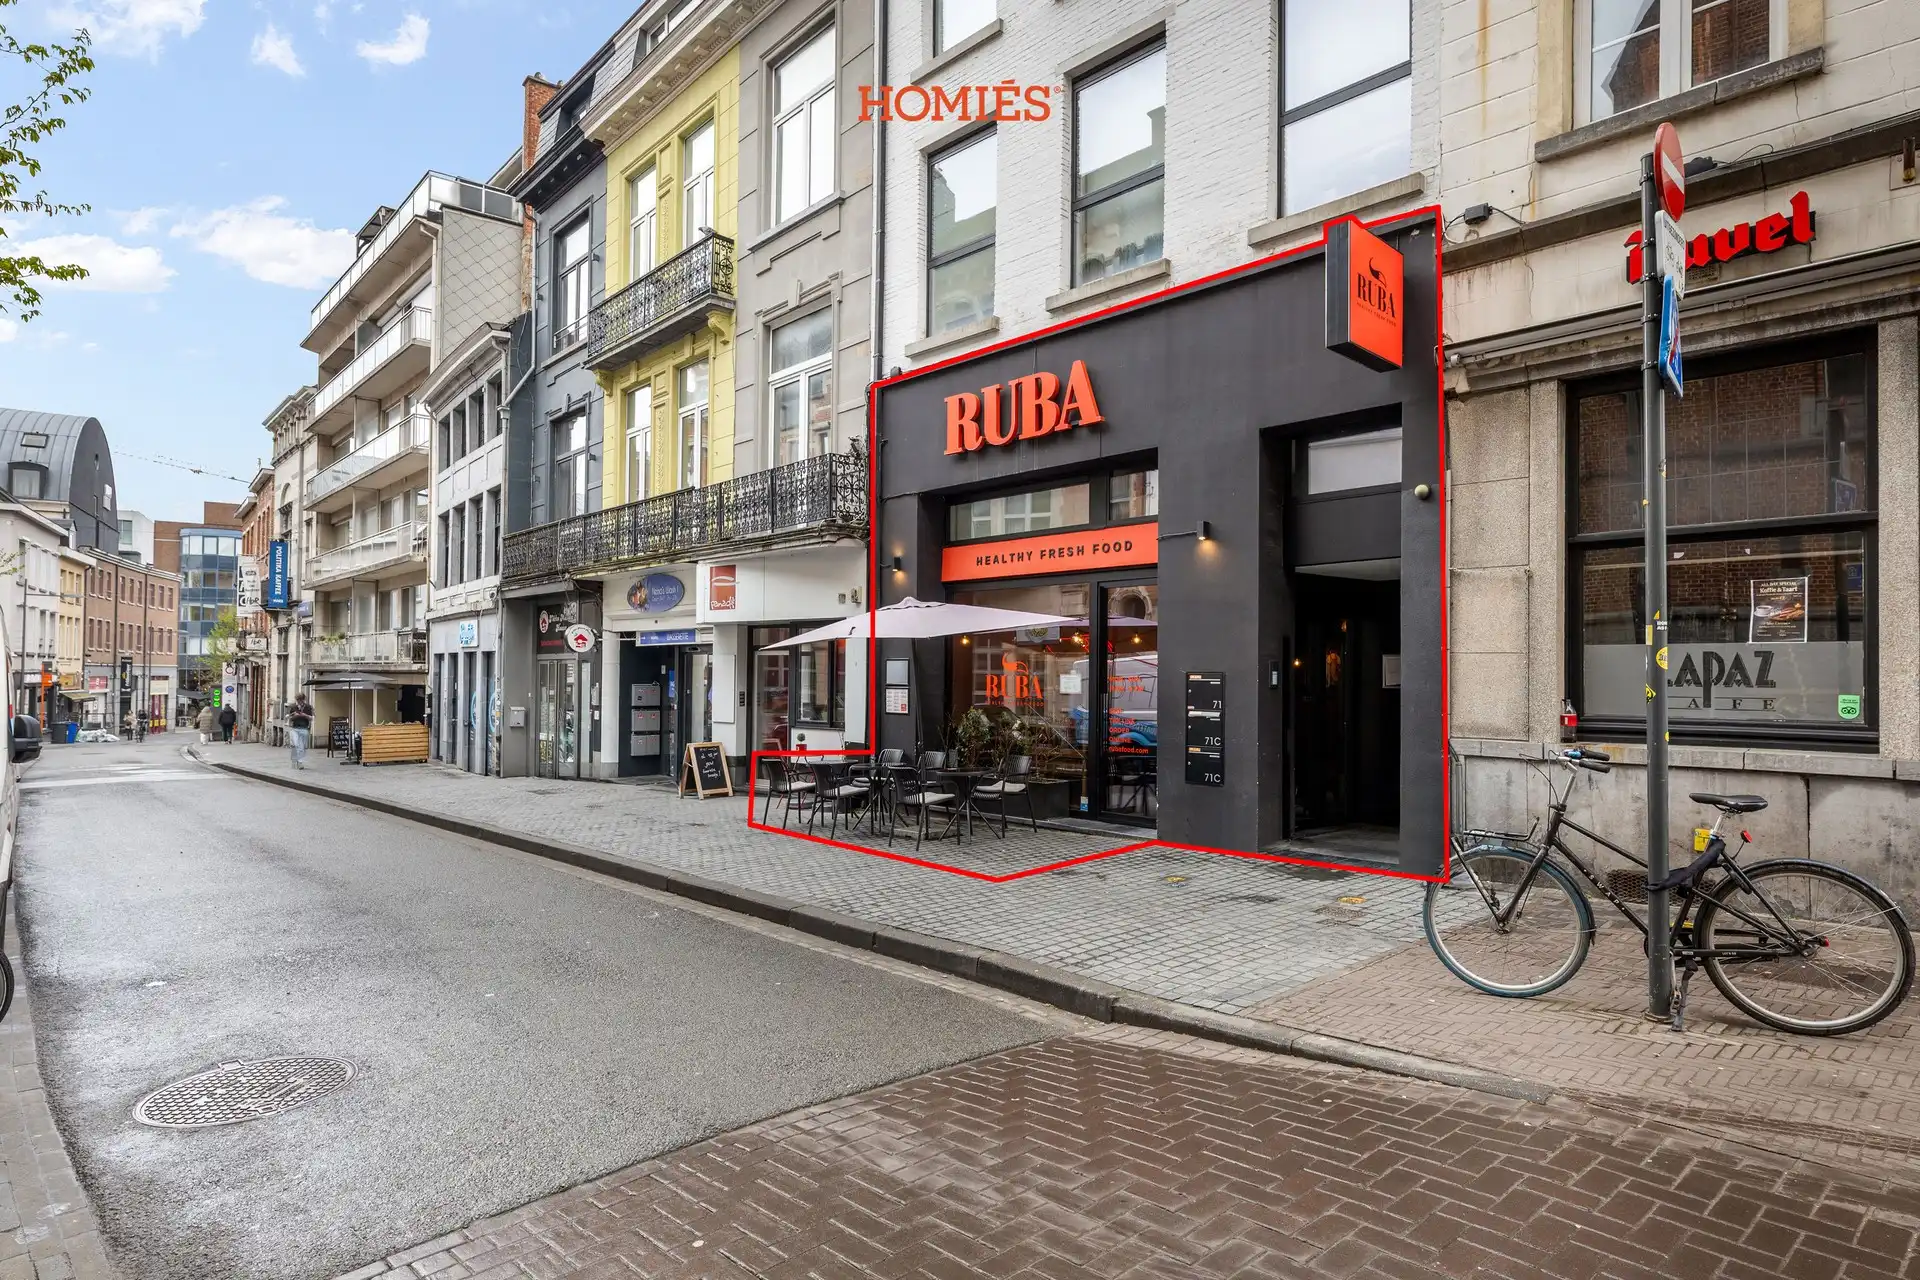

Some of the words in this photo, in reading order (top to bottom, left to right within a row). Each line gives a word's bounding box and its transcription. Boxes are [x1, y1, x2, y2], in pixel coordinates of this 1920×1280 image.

[1357, 272, 1396, 319] RUBA
[944, 359, 1105, 455] RUBA
[275, 545, 283, 573] POLITIKA
[976, 550, 1033, 566] HEALTHY
[1040, 545, 1085, 560] FRESH
[1092, 540, 1133, 554] FOOD
[274, 574, 282, 595] KAFFEE
[985, 674, 1044, 699] RUBA
[1667, 651, 1777, 708] APAZ
[1213, 700, 1222, 709] 71
[1205, 737, 1221, 745] 71C
[1204, 773, 1221, 783] 71C
